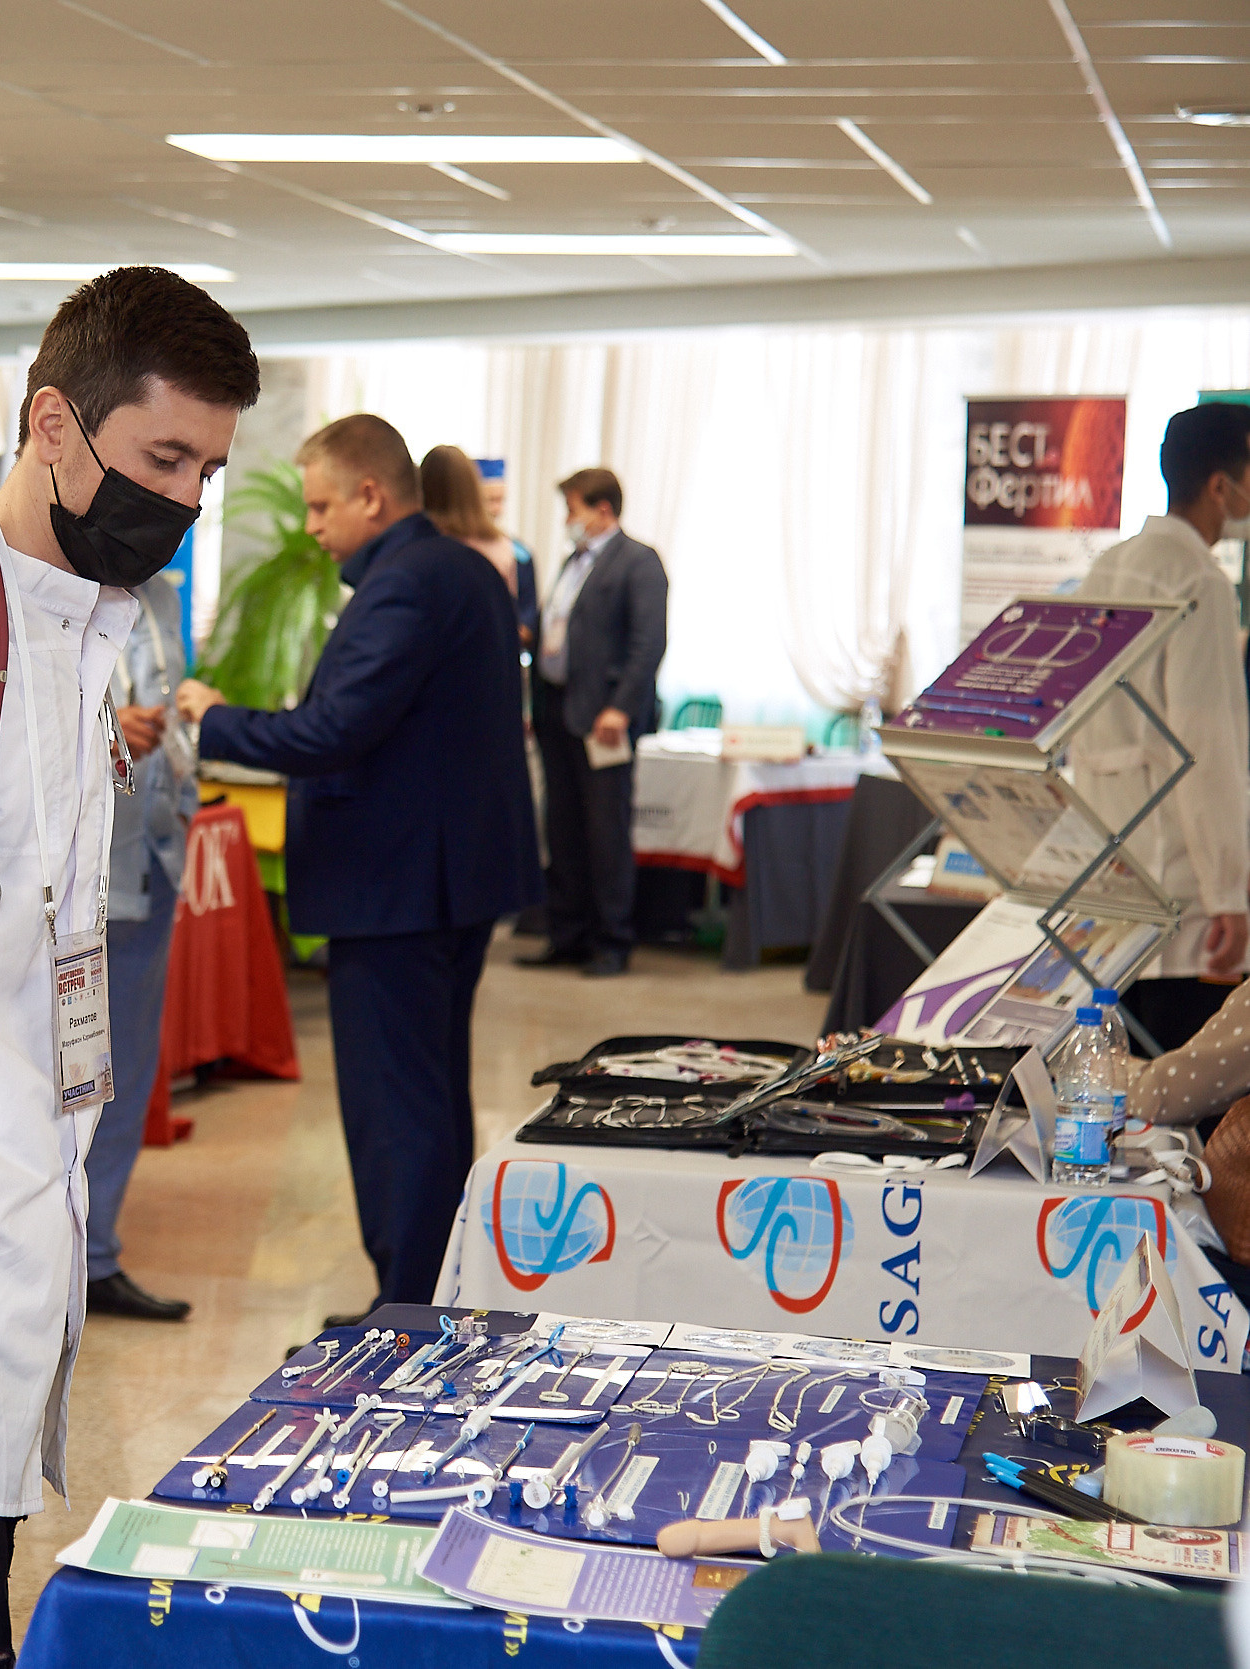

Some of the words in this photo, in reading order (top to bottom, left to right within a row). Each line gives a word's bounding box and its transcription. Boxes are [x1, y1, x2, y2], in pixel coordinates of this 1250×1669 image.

[58, 976, 85, 995] ВСТРЕЧИ
[69, 1012, 97, 1029] Рахматов
[63, 1081, 95, 1100] УЧАСТНИК
[879, 1178, 925, 1336] SAG
